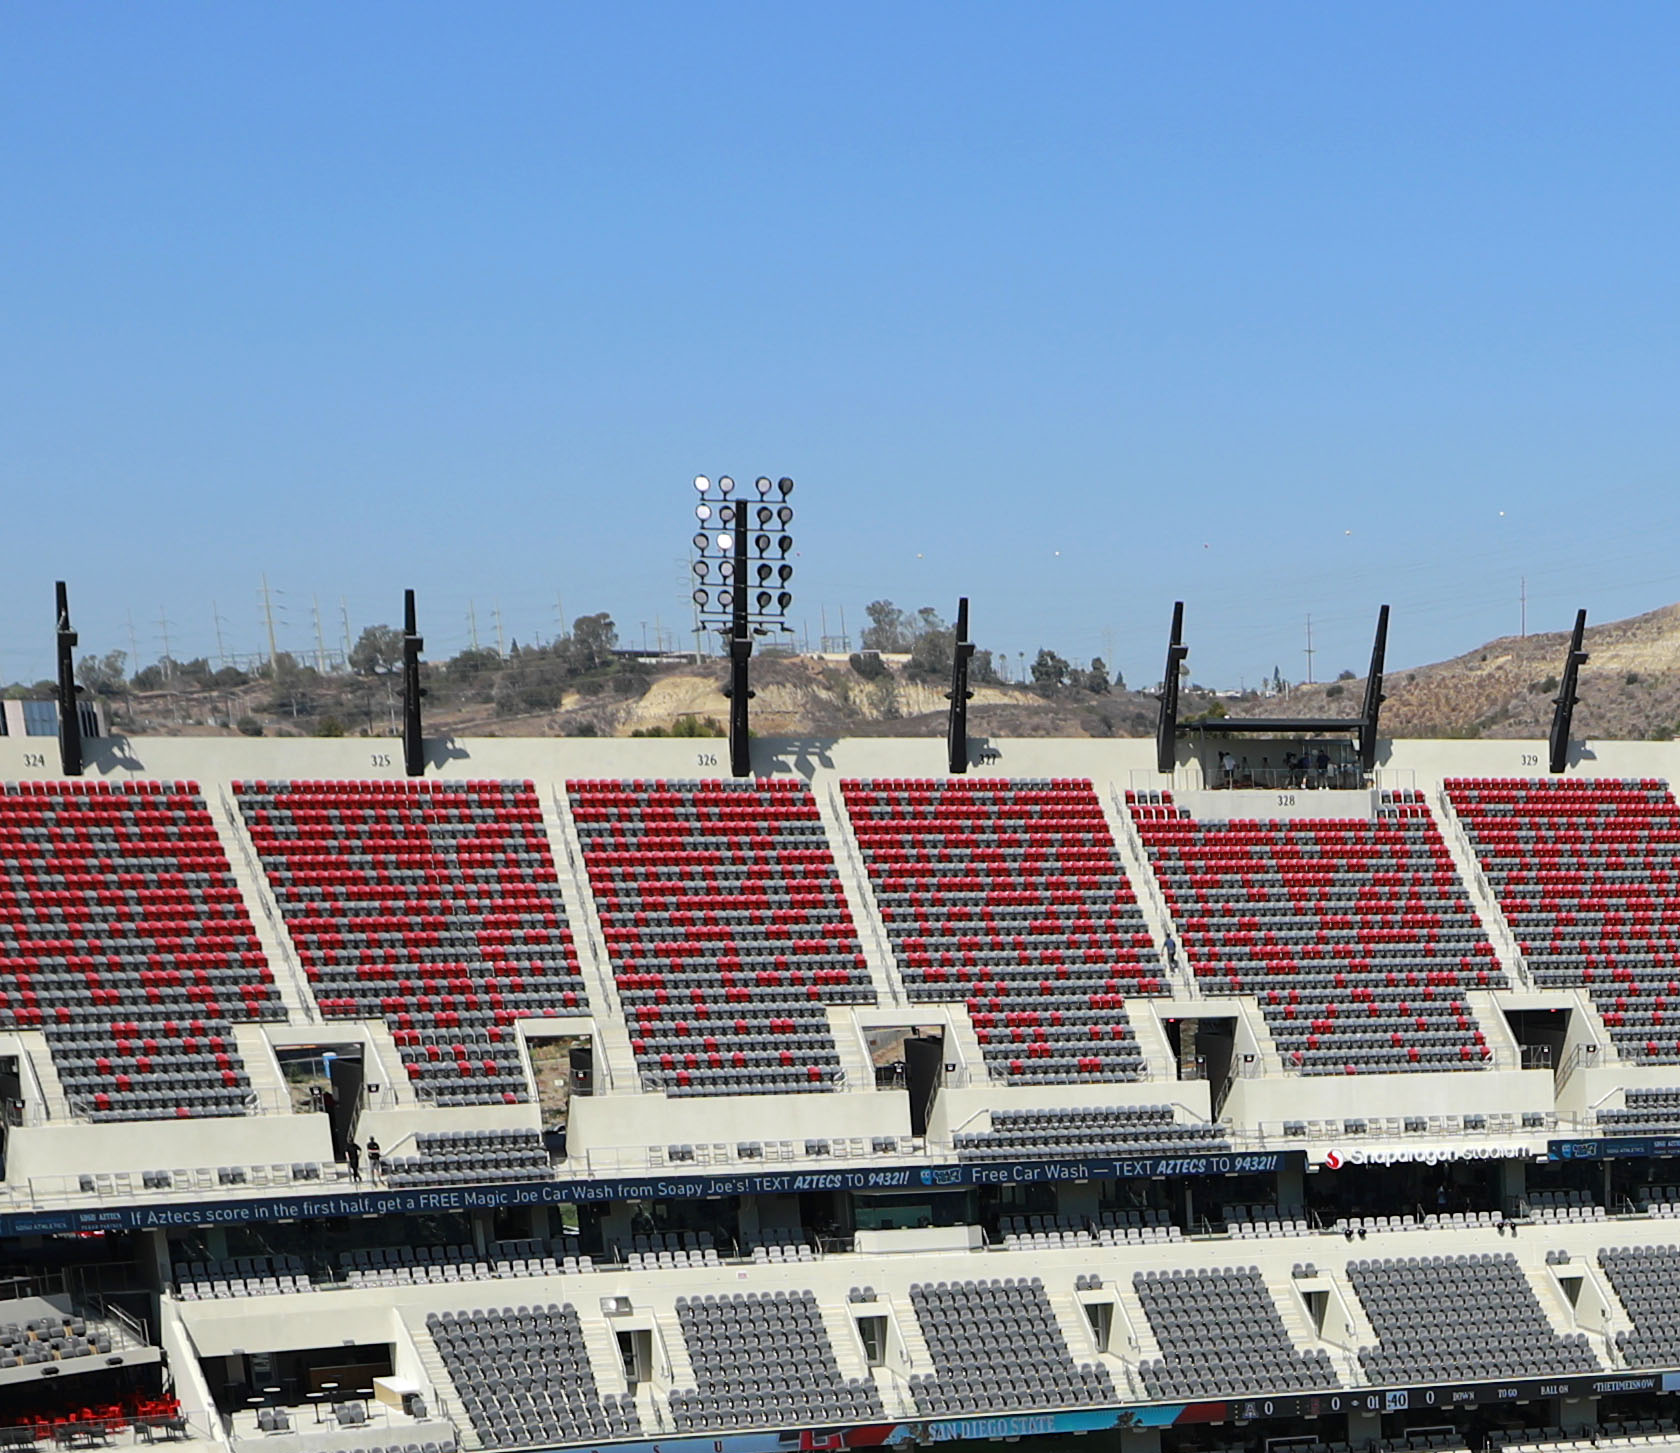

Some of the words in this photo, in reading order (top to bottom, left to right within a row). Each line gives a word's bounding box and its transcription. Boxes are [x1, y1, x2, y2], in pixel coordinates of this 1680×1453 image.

[24, 754, 45, 767] 324
[371, 755, 390, 767] 325
[697, 755, 717, 766] 326
[979, 753, 996, 765] 327
[1521, 755, 1538, 766] 329
[1278, 795, 1295, 807] 328
[1351, 1149, 1458, 1167] Snapdragon
[1463, 1147, 1533, 1160] stadium
[973, 1167, 1007, 1182] Free
[1014, 1165, 1040, 1180] Car
[1045, 1164, 1088, 1179] Wash
[1113, 1160, 1152, 1176] TEXT
[1157, 1158, 1206, 1174] AZTECS
[1210, 1157, 1229, 1172] TO
[131, 1211, 140, 1225] If
[148, 1210, 200, 1224] Aztecs
[207, 1208, 249, 1222] score
[255, 1204, 268, 1218] in
[274, 1203, 298, 1216] the
[304, 1201, 335, 1215] first
[340, 1198, 374, 1213] half,
[377, 1198, 401, 1214] get
[407, 1199, 414, 1209] a
[420, 1194, 459, 1208] FREE
[464, 1190, 507, 1208] Magic
[513, 1189, 537, 1203] Joe
[543, 1188, 569, 1201] Car
[571, 1184, 613, 1199] Wash
[618, 1185, 653, 1198] from
[658, 1182, 702, 1197] Soapy
[707, 1178, 748, 1193] Joe's!
[754, 1177, 789, 1191] TEXT
[794, 1174, 841, 1189] AZTECS
[846, 1173, 863, 1187] TO
[1452, 1391, 1475, 1402] DOWN
[1498, 1389, 1507, 1398] TO
[1508, 1388, 1518, 1397] GO
[1540, 1386, 1558, 1396] BALL
[1559, 1385, 1569, 1394] ON
[928, 1424, 958, 1440] SAN
[961, 1420, 1008, 1438] DIEGO
[1010, 1416, 1056, 1434] STATE
